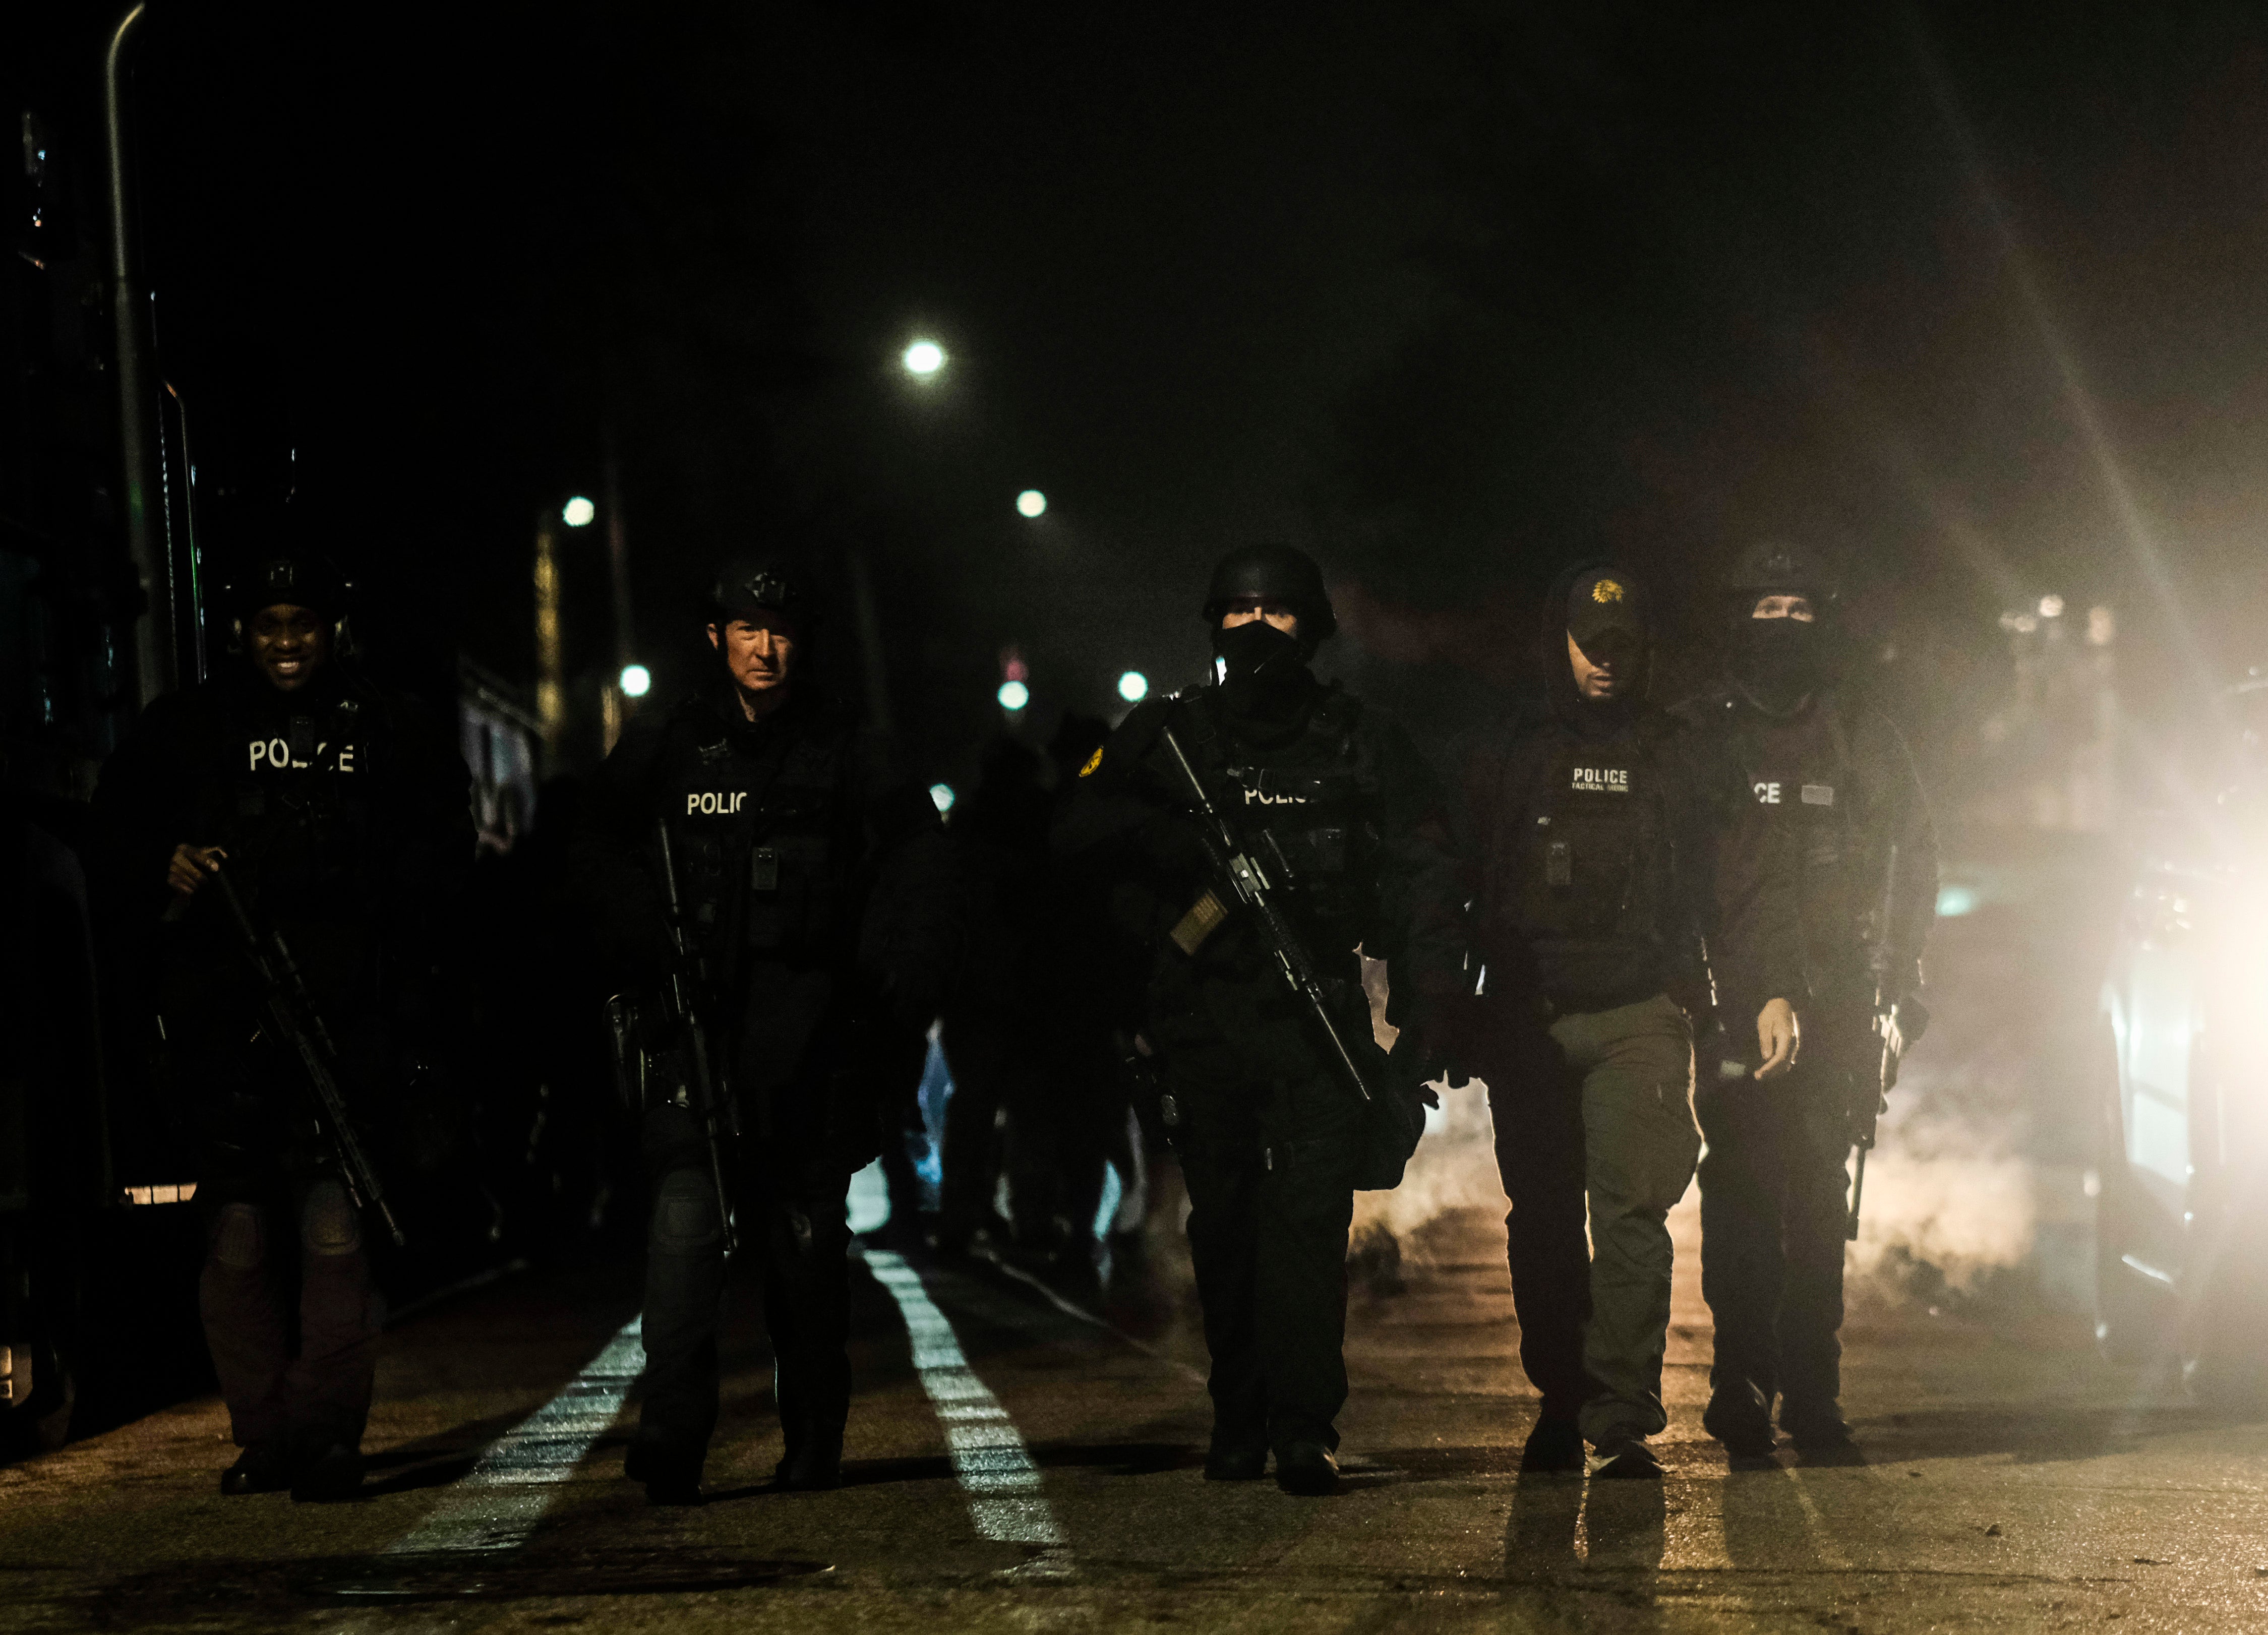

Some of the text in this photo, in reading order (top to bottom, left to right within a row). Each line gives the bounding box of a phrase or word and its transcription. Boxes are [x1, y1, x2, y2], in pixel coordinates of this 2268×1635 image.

[250, 738, 353, 772] POE
[1574, 768, 1627, 783] POLICE
[1572, 782, 1604, 791] TACTICAL
[687, 792, 747, 815] POLIC
